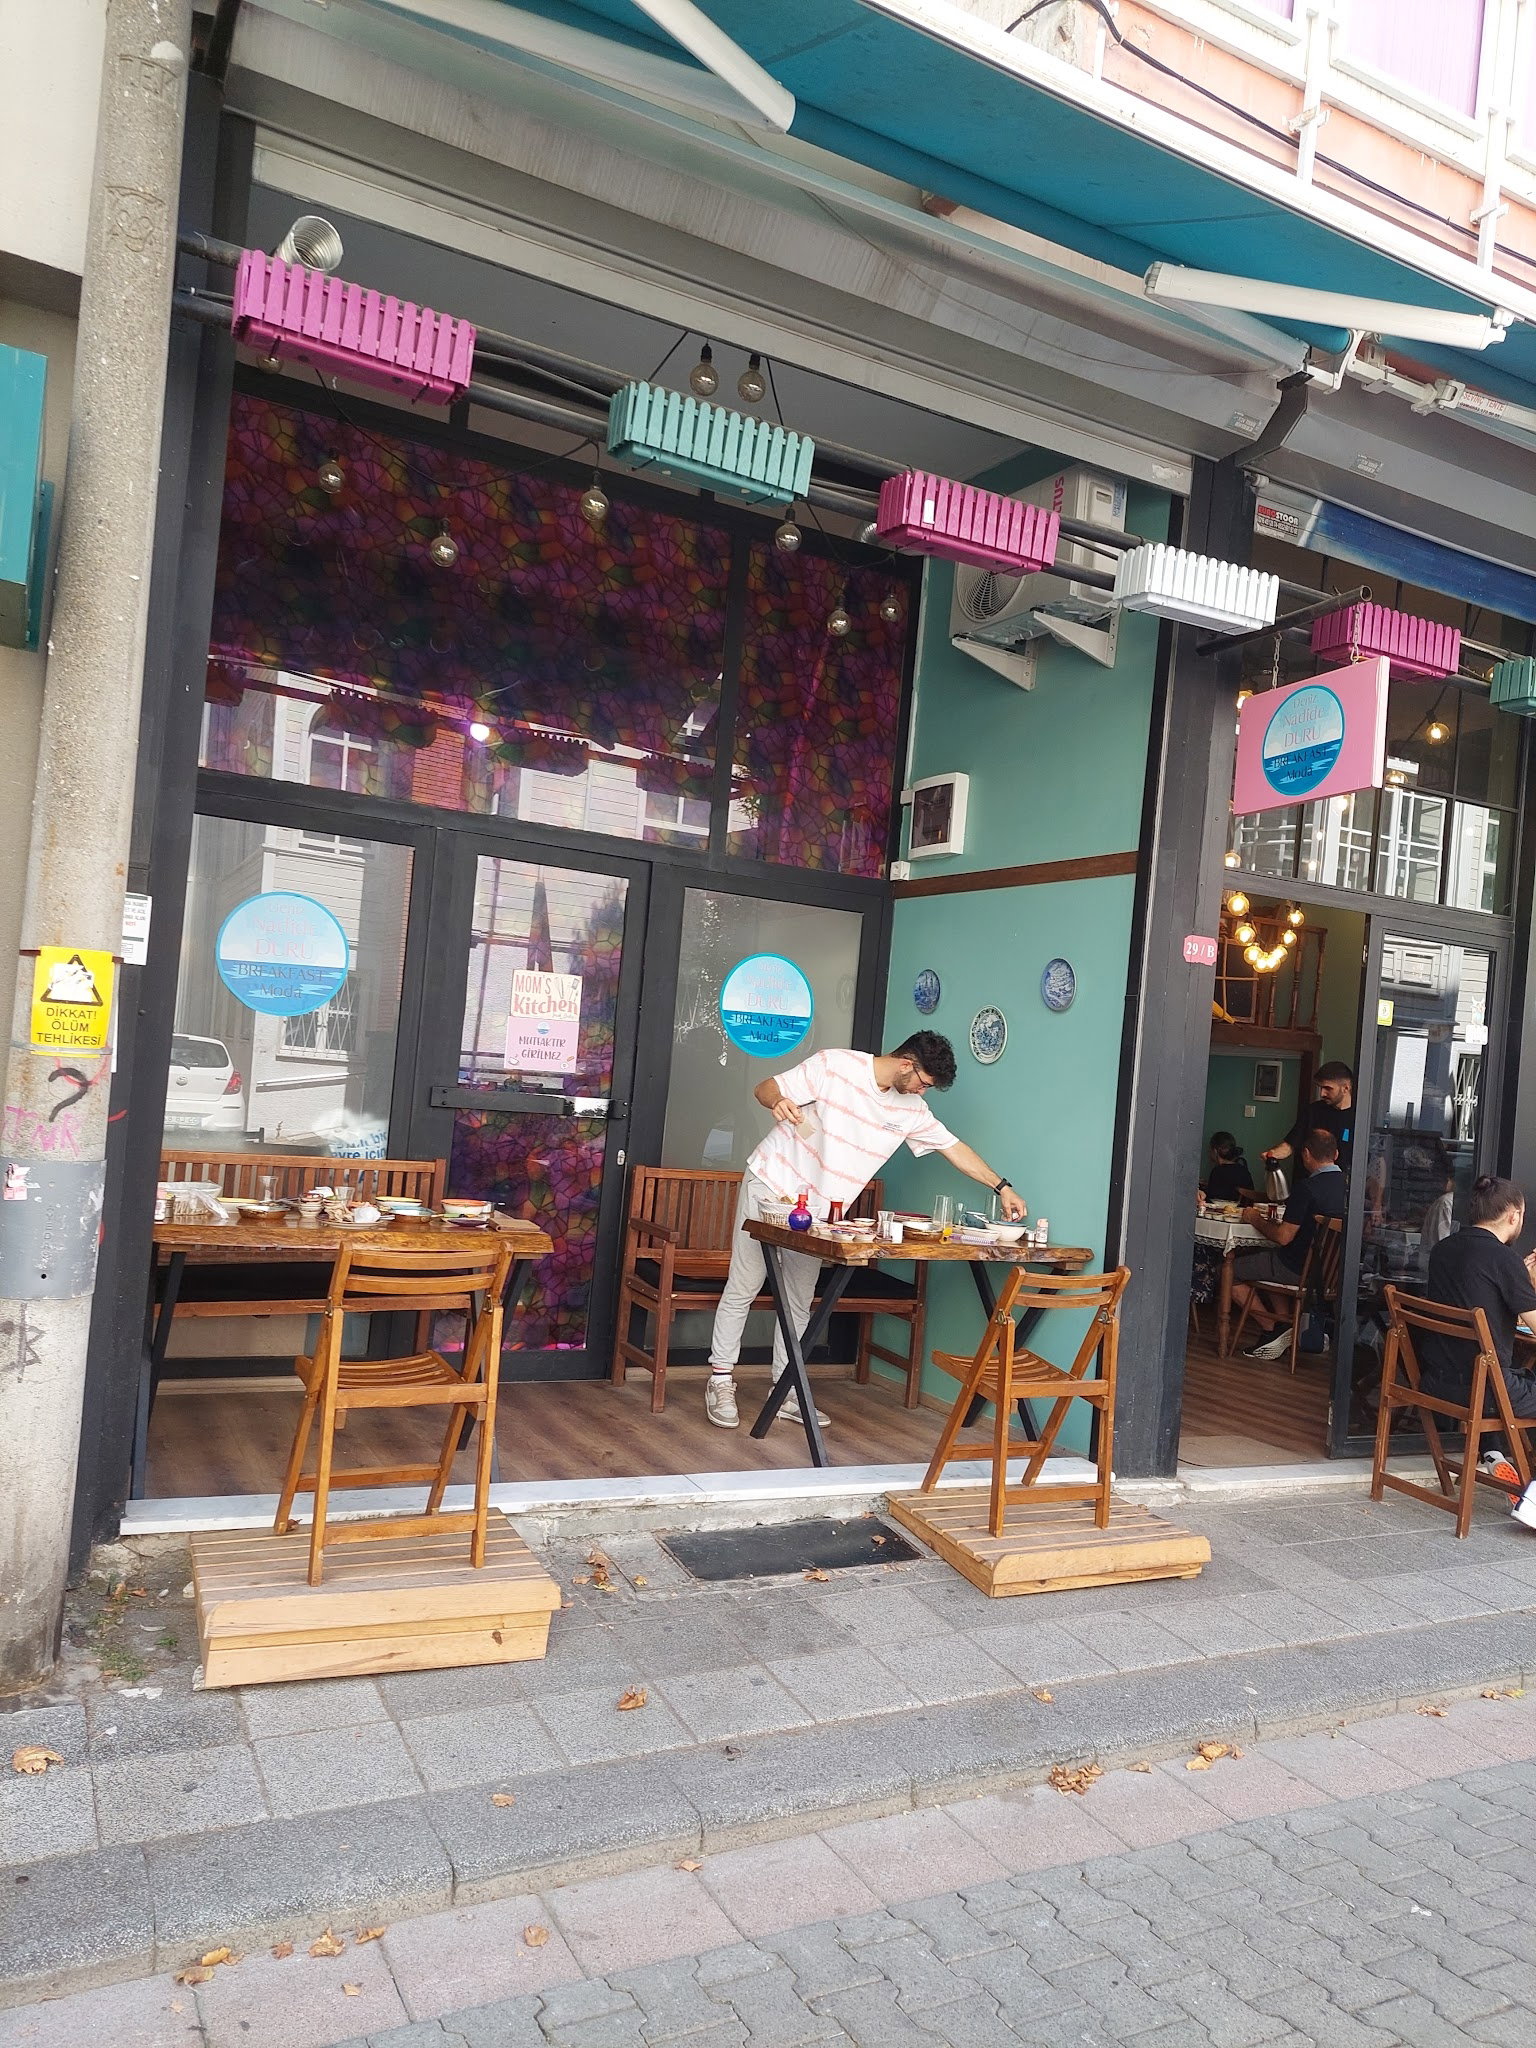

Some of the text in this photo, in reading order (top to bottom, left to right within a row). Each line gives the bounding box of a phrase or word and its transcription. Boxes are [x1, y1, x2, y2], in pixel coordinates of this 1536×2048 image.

[1053, 476, 1064, 513] LTUS
[1284, 725, 1322, 748] DURU
[1273, 746, 1328, 769] BREAKFAST
[1286, 765, 1313, 781] Moda
[256, 938, 314, 960] DURU
[239, 963, 325, 981] BREAKFAST
[260, 983, 301, 999] Moda
[514, 974, 552, 995] MOM'S
[513, 993, 578, 1016] Kitchen
[46, 1006, 97, 1020] DİKKAT!
[735, 1013, 796, 1029] BREAKFAST
[51, 1018, 89, 1032] ÖLÜM
[36, 1032, 102, 1046] TEHLİKESİ
[750, 1030, 779, 1043] Moda
[521, 1047, 562, 1061] GİRİLMEZ
